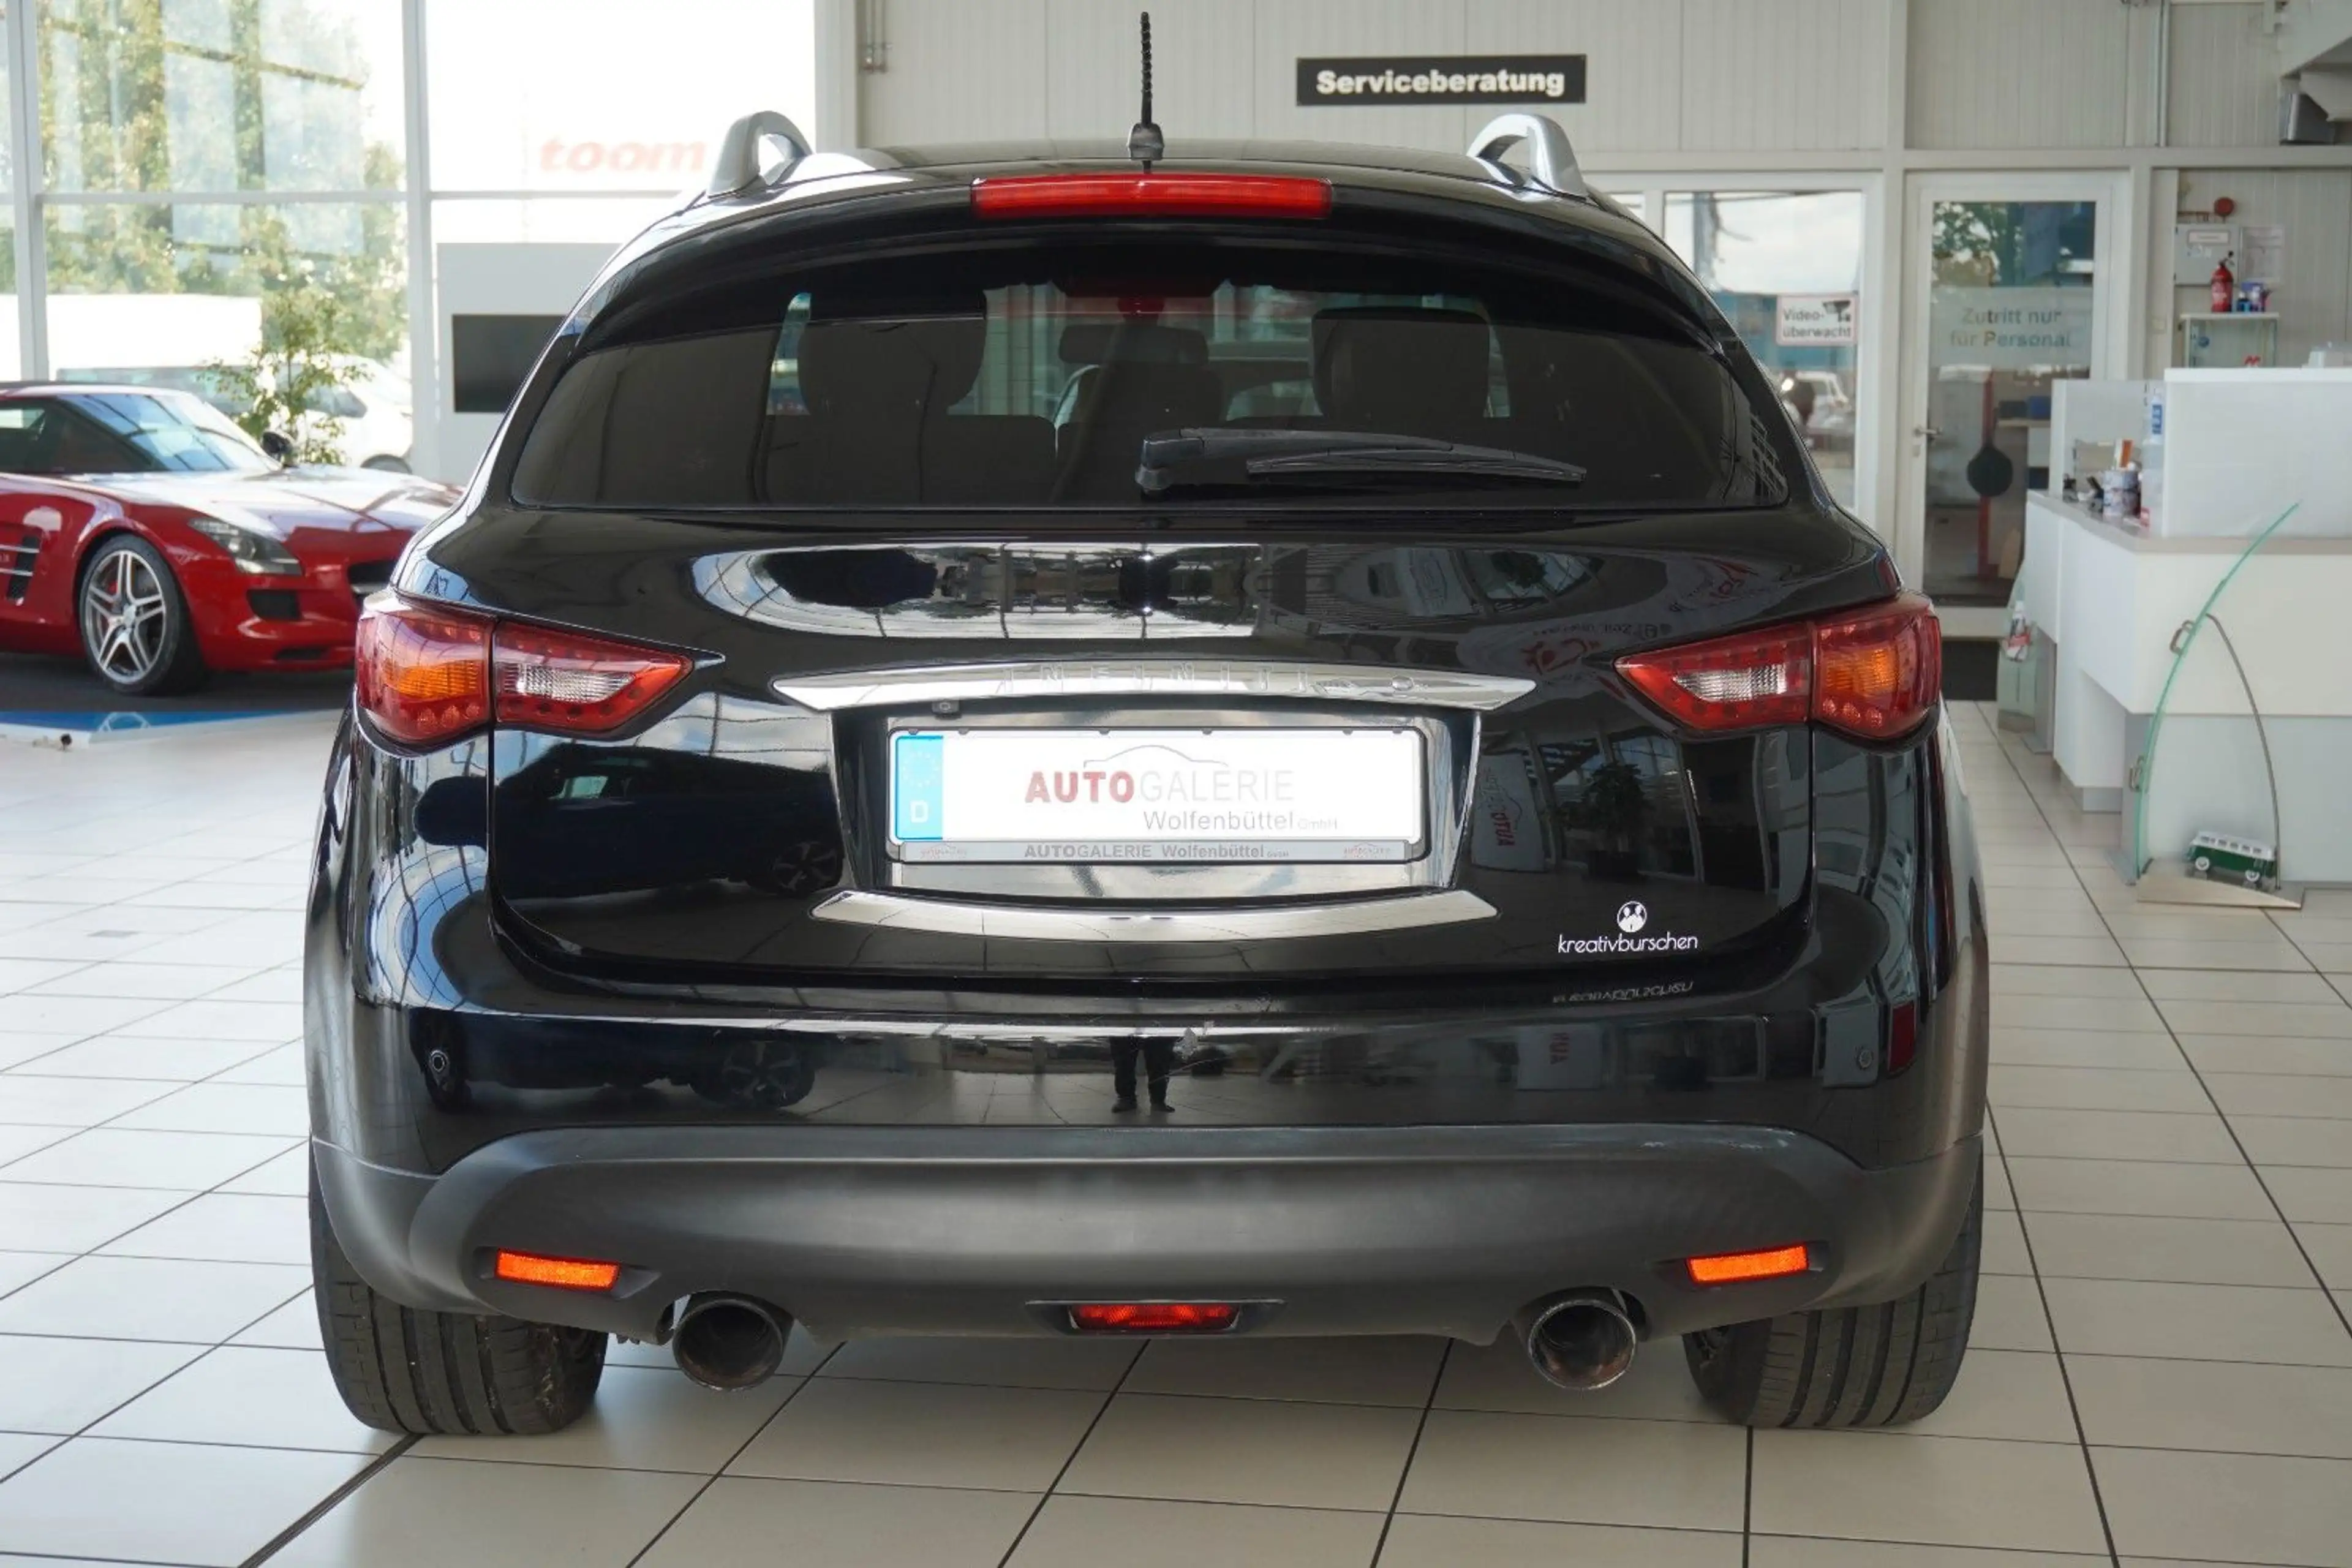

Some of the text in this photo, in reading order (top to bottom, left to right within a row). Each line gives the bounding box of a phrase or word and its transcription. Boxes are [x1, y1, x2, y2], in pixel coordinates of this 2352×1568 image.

[1317, 69, 1565, 97] Serviceberatung
[540, 137, 706, 172] toom
[1783, 307, 1825, 321] Video-
[1962, 307, 2062, 325] Zutritt nur
[1783, 323, 1851, 337] überwacht
[1950, 329, 2071, 347] für Personal
[910, 801, 929, 823] D
[1143, 810, 1294, 831] Wolfenbüttel
[1024, 844, 1152, 858] AUTOGALERIE
[1162, 844, 1264, 859] Wolfenbüttel
[1558, 931, 1699, 954] kreativburschen
